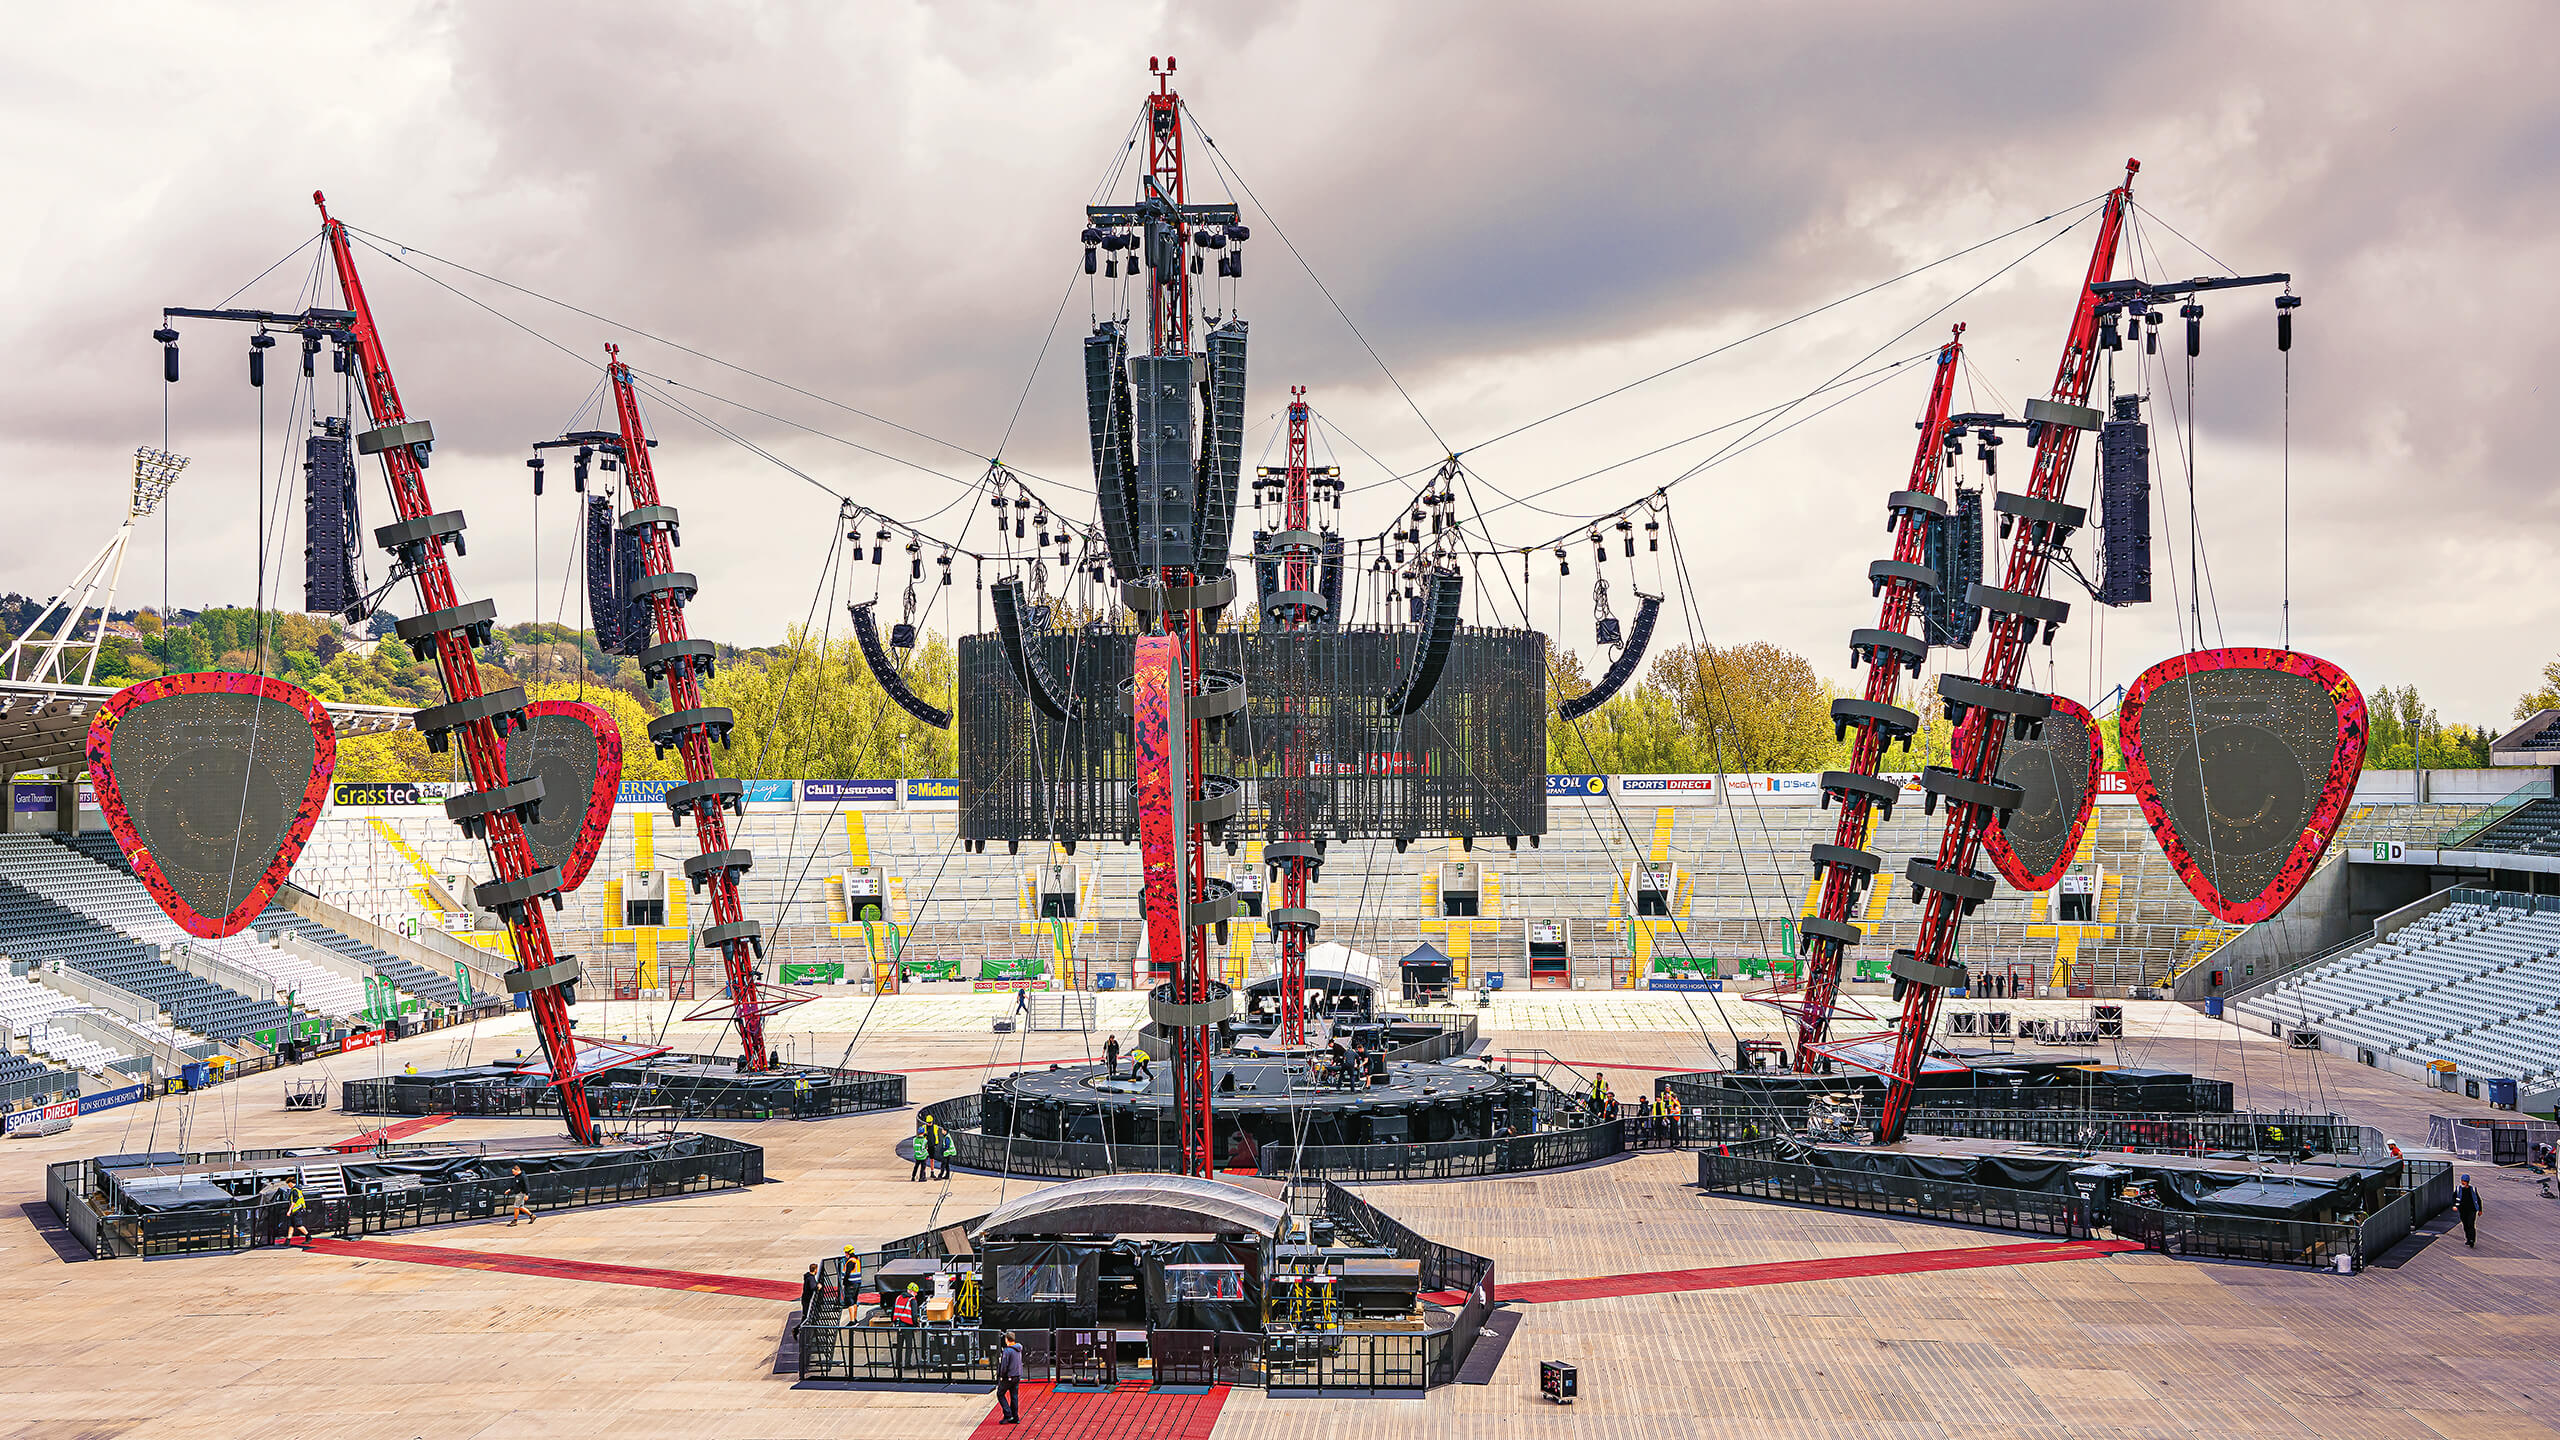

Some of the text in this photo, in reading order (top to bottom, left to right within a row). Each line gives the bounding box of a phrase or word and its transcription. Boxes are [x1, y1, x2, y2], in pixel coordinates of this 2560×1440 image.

[1560, 777, 1581, 788] OIL
[1625, 781, 1709, 789] SPORTS DIRECT
[334, 784, 415, 804] Grasstec
[806, 785, 893, 795] Chill Insurance
[16, 793, 53, 803] Grant Thornton
[618, 794, 664, 802] MILLING
[2392, 845, 2402, 858] D
[399, 922, 405, 934] C
[80, 1102, 92, 1112] BON
[8, 1102, 76, 1130] SPORTS DIRECT
